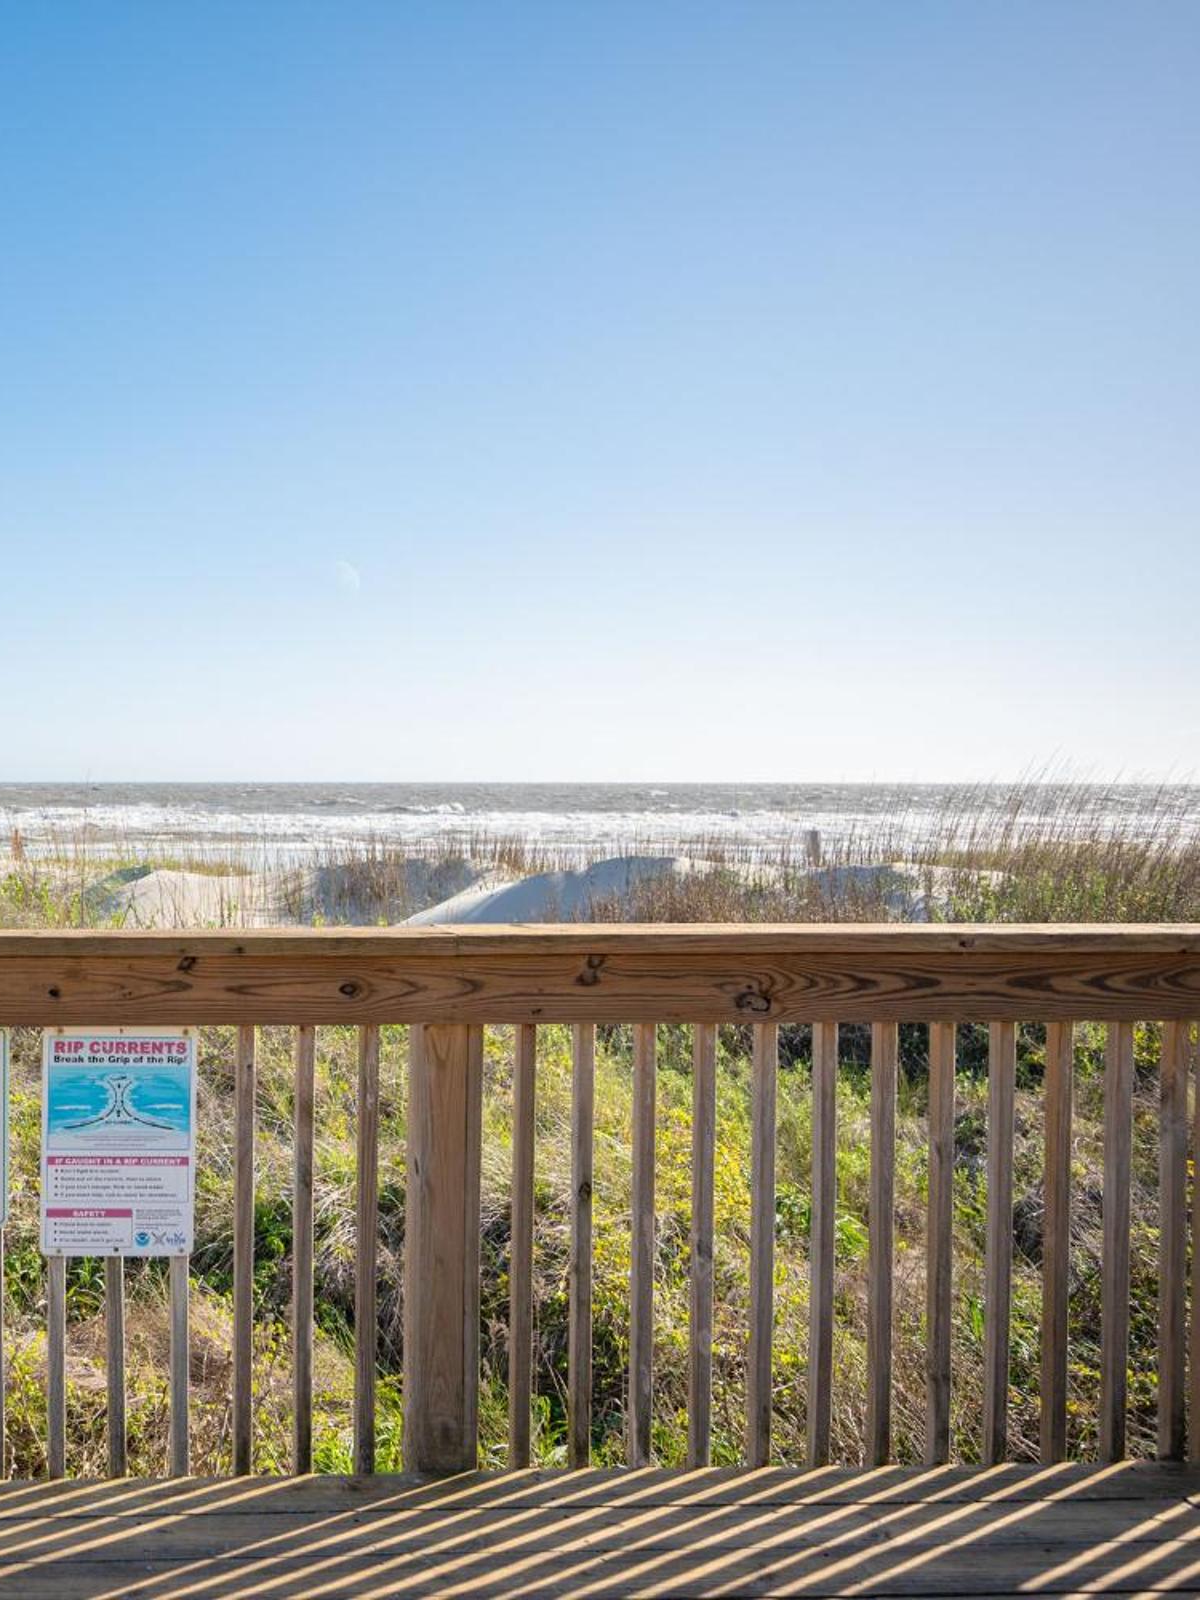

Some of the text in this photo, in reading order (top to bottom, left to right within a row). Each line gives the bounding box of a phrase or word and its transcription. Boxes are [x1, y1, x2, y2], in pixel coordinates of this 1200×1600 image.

[54, 1041, 187, 1054] RIP CURRENTS
[108, 1056, 130, 1064] Grip
[167, 1056, 187, 1064] Rip!
